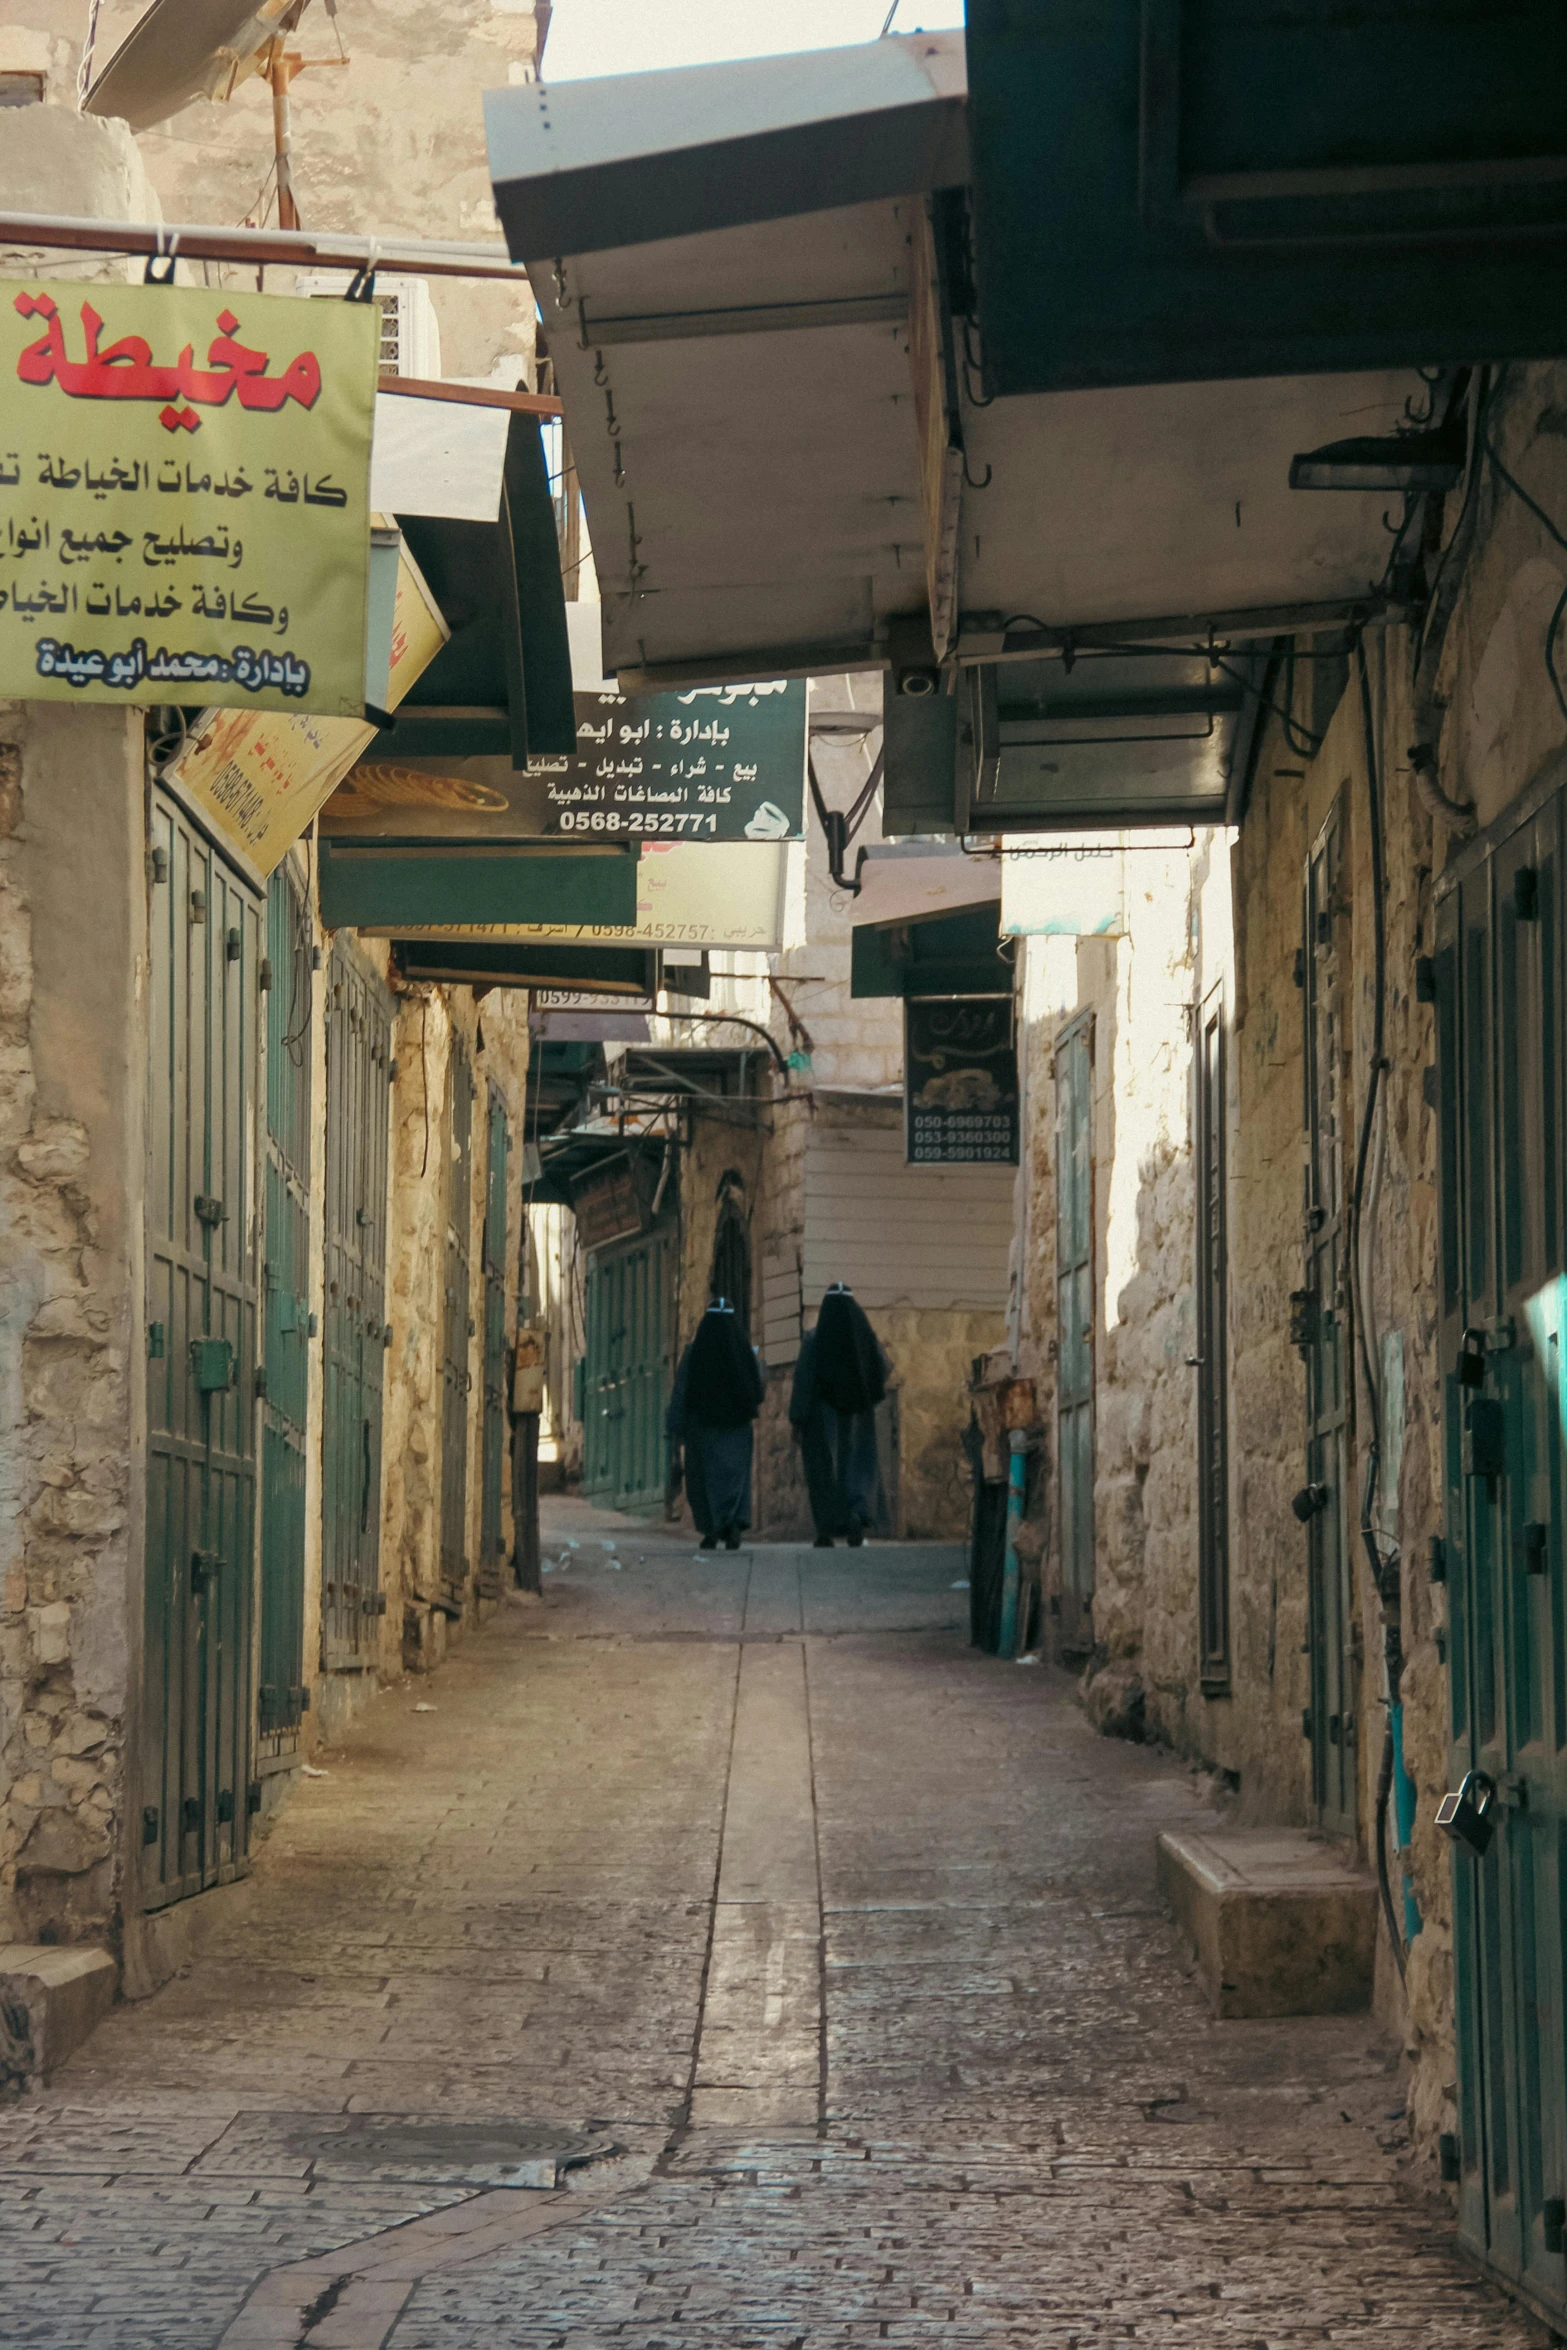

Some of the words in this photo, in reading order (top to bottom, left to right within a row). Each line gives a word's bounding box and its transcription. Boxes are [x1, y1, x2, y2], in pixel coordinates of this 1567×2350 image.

[13, 291, 322, 432] مخيطة
[38, 454, 149, 500] الخياطة
[156, 466, 253, 497] خدمات
[264, 472, 348, 508] كافة
[59, 528, 132, 564] جميع
[143, 525, 243, 568] وتصليح
[86, 583, 182, 618] خدمات
[192, 585, 289, 635] وكافة
[576, 718, 612, 744] ايه
[619, 718, 650, 745] ابو
[670, 719, 730, 746] بإدارة
[595, 757, 643, 778] تبديل
[670, 757, 706, 779] شراء
[733, 762, 758, 781] بيع
[547, 783, 605, 805] الذهبية
[614, 784, 688, 803] المصاغات
[698, 786, 732, 803] كافة
[559, 811, 718, 833] 0568-252771
